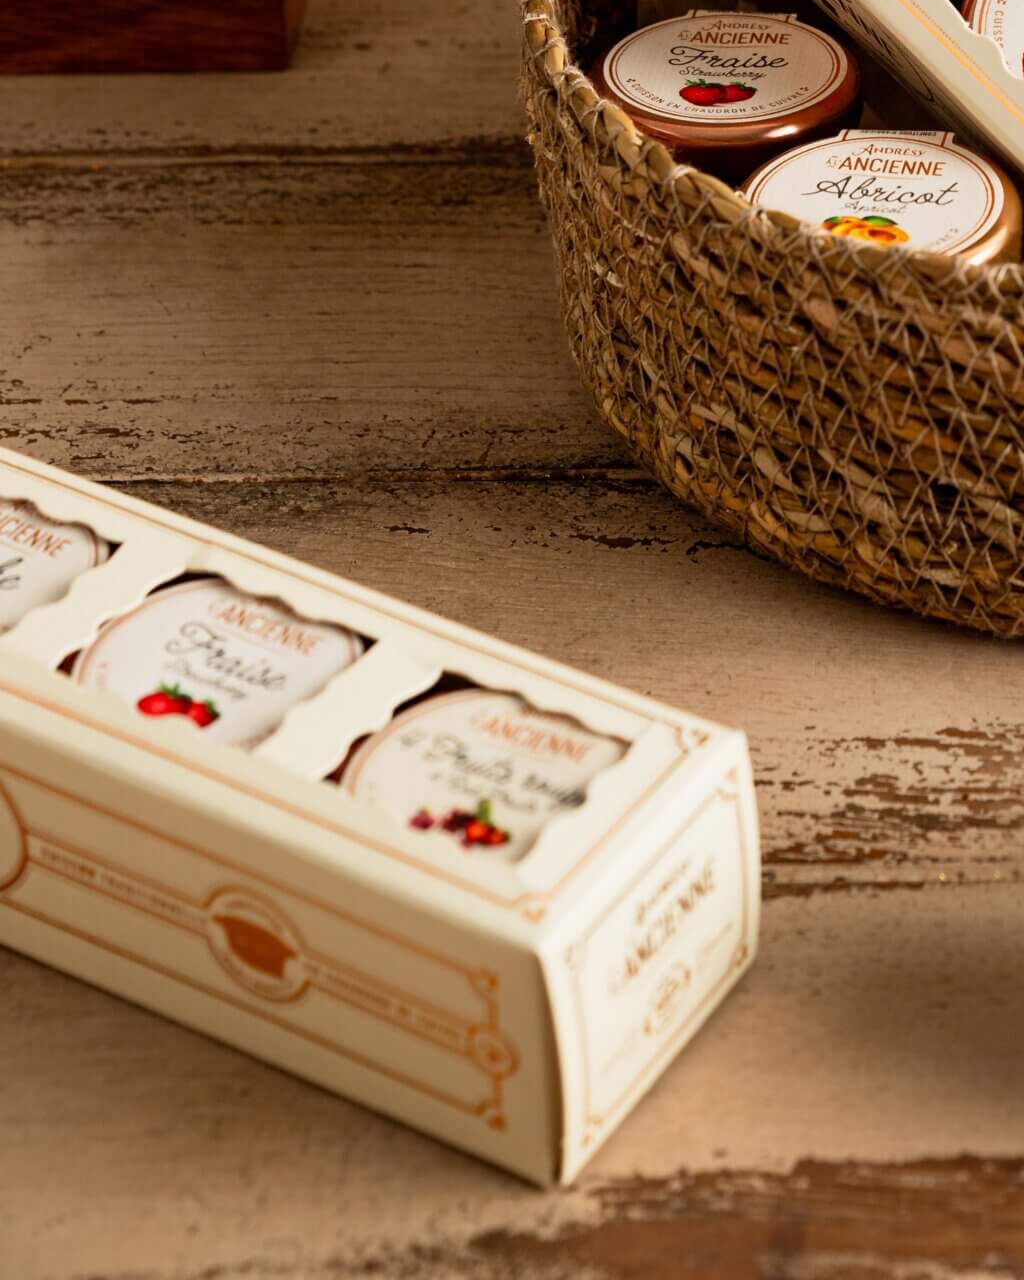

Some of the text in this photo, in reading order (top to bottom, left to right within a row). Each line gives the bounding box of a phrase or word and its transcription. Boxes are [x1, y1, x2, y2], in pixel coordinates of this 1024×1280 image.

[668, 45, 790, 69] Fraise
[678, 65, 768, 81] Strawberry
[631, 82, 666, 104] CUISSON
[667, 101, 680, 110] EN
[684, 106, 747, 114] CHAUDRON
[800, 175, 960, 207] Abricot
[0, 514, 73, 558] CIENNE
